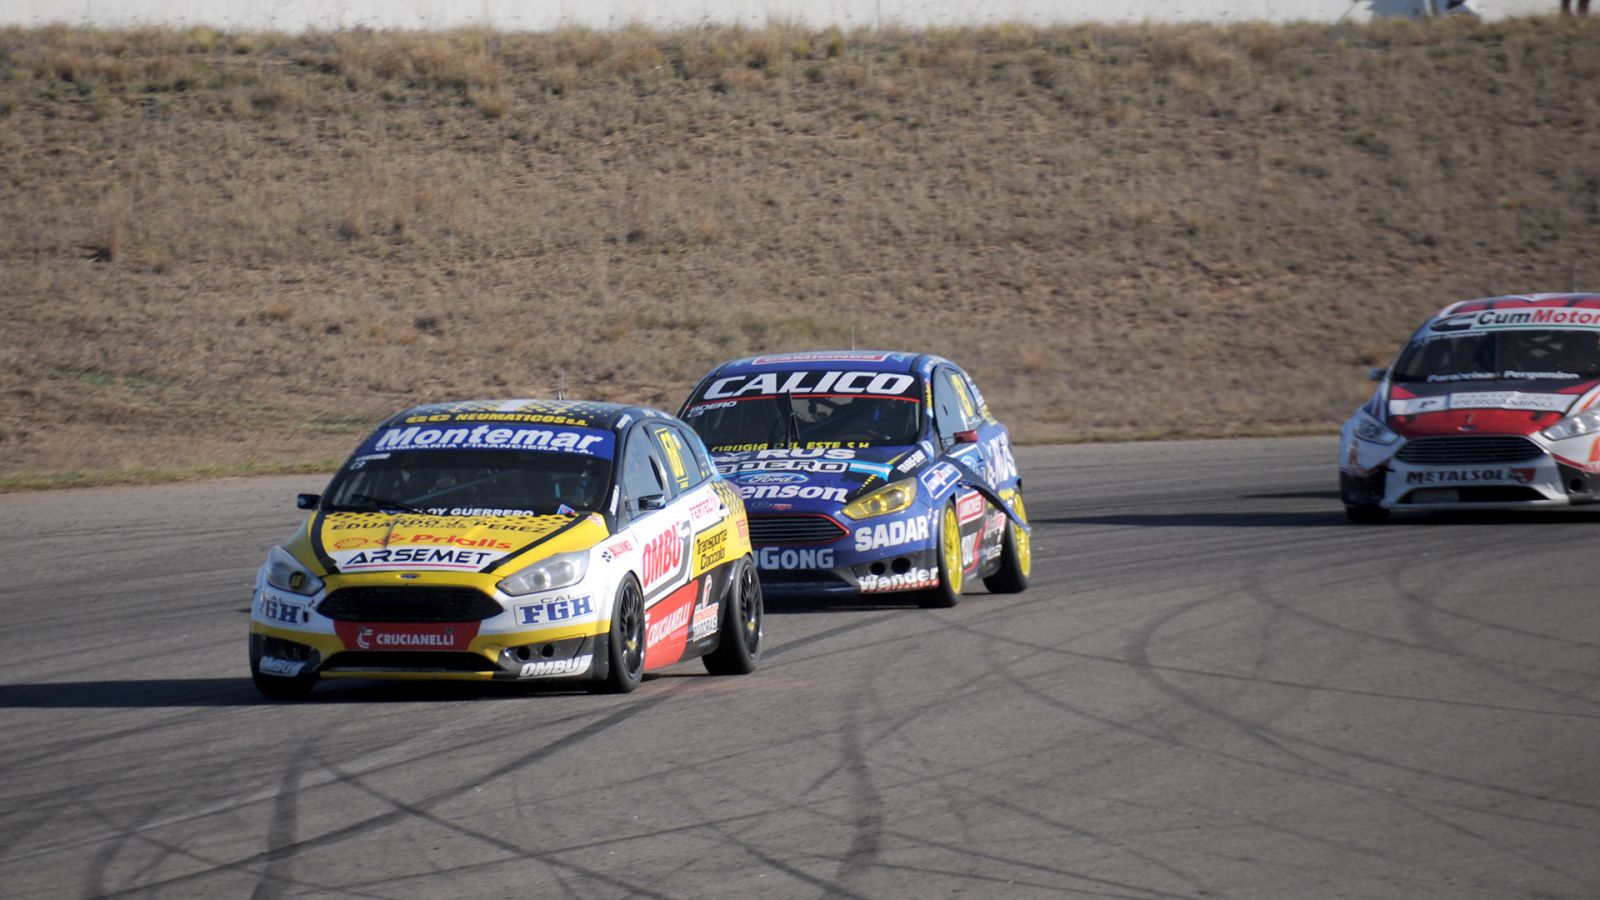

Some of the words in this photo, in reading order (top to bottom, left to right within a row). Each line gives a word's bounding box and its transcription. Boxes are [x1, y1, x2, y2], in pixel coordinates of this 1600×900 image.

[704, 371, 914, 399] CALICO
[455, 413, 567, 424] NEUMATICOS
[375, 424, 604, 450] Montemar
[711, 443, 769, 452] CIRUGIA
[807, 442, 841, 450] ESTE
[756, 449, 856, 460] RUS
[1405, 469, 1504, 484] METALSOL
[742, 484, 849, 503] enson
[450, 508, 534, 517] GUERRERO
[331, 518, 437, 530] EDUARDO
[855, 515, 930, 552] SADAR
[345, 548, 492, 566] ARSEMET
[857, 566, 939, 591] Wander
[520, 595, 593, 625] FGH
[376, 633, 455, 645] CRUCIANELLI
[519, 656, 584, 677] OMBU
